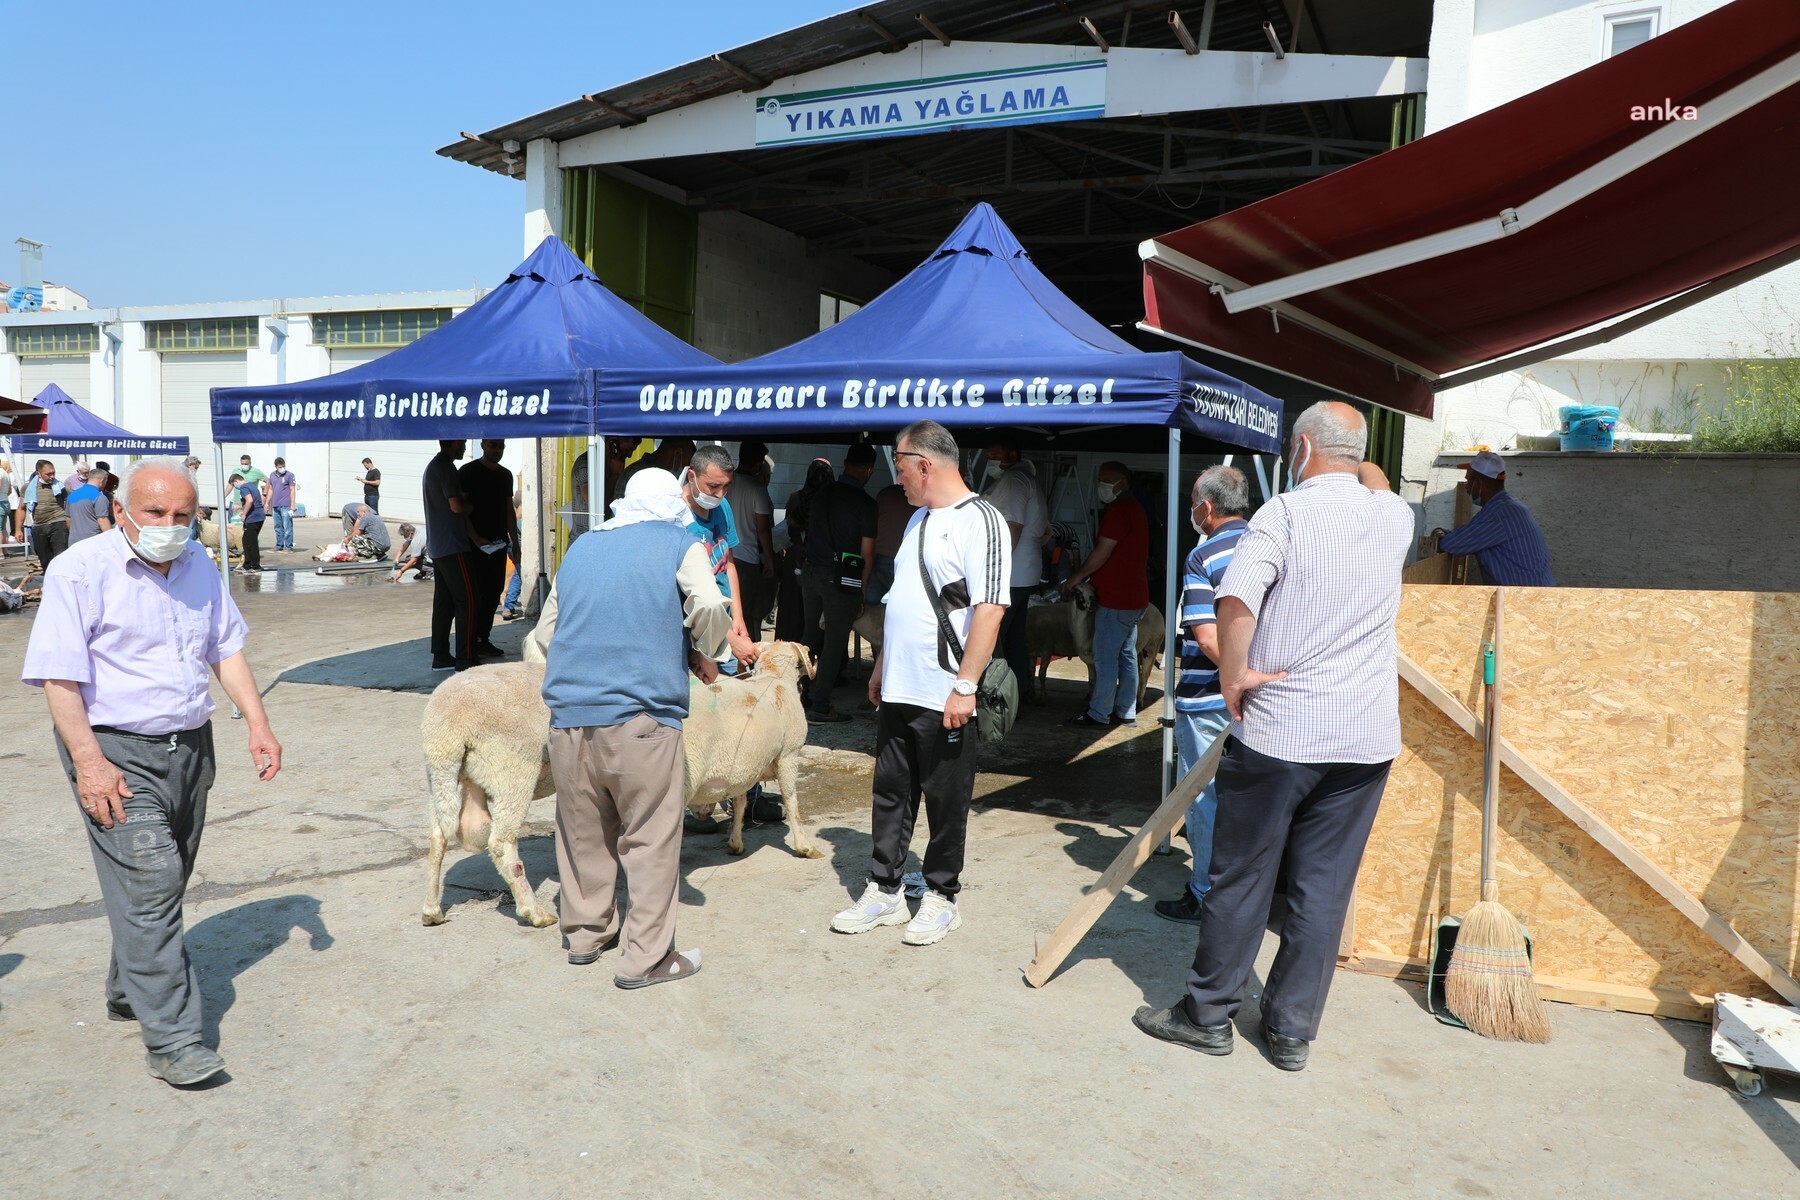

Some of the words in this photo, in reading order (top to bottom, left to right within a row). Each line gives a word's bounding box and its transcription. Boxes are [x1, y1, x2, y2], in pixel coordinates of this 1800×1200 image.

[786, 103, 903, 132] YIKAMA
[914, 86, 1070, 121] YAĞLAMA
[239, 399, 366, 427] Odunpazarı
[374, 391, 469, 418] Birlikte
[477, 389, 551, 417] Güzel
[639, 383, 828, 416] Odunpazarı
[841, 378, 985, 409] Birlikte
[1001, 377, 1115, 407] Güzel
[1191, 383, 1248, 427] ODUNPAZARI
[1247, 401, 1279, 438] BELEDİYESİ
[38, 438, 103, 450] Odunpazarı
[106, 440, 147, 449] Birlikte
[149, 440, 177, 450] Güzel
